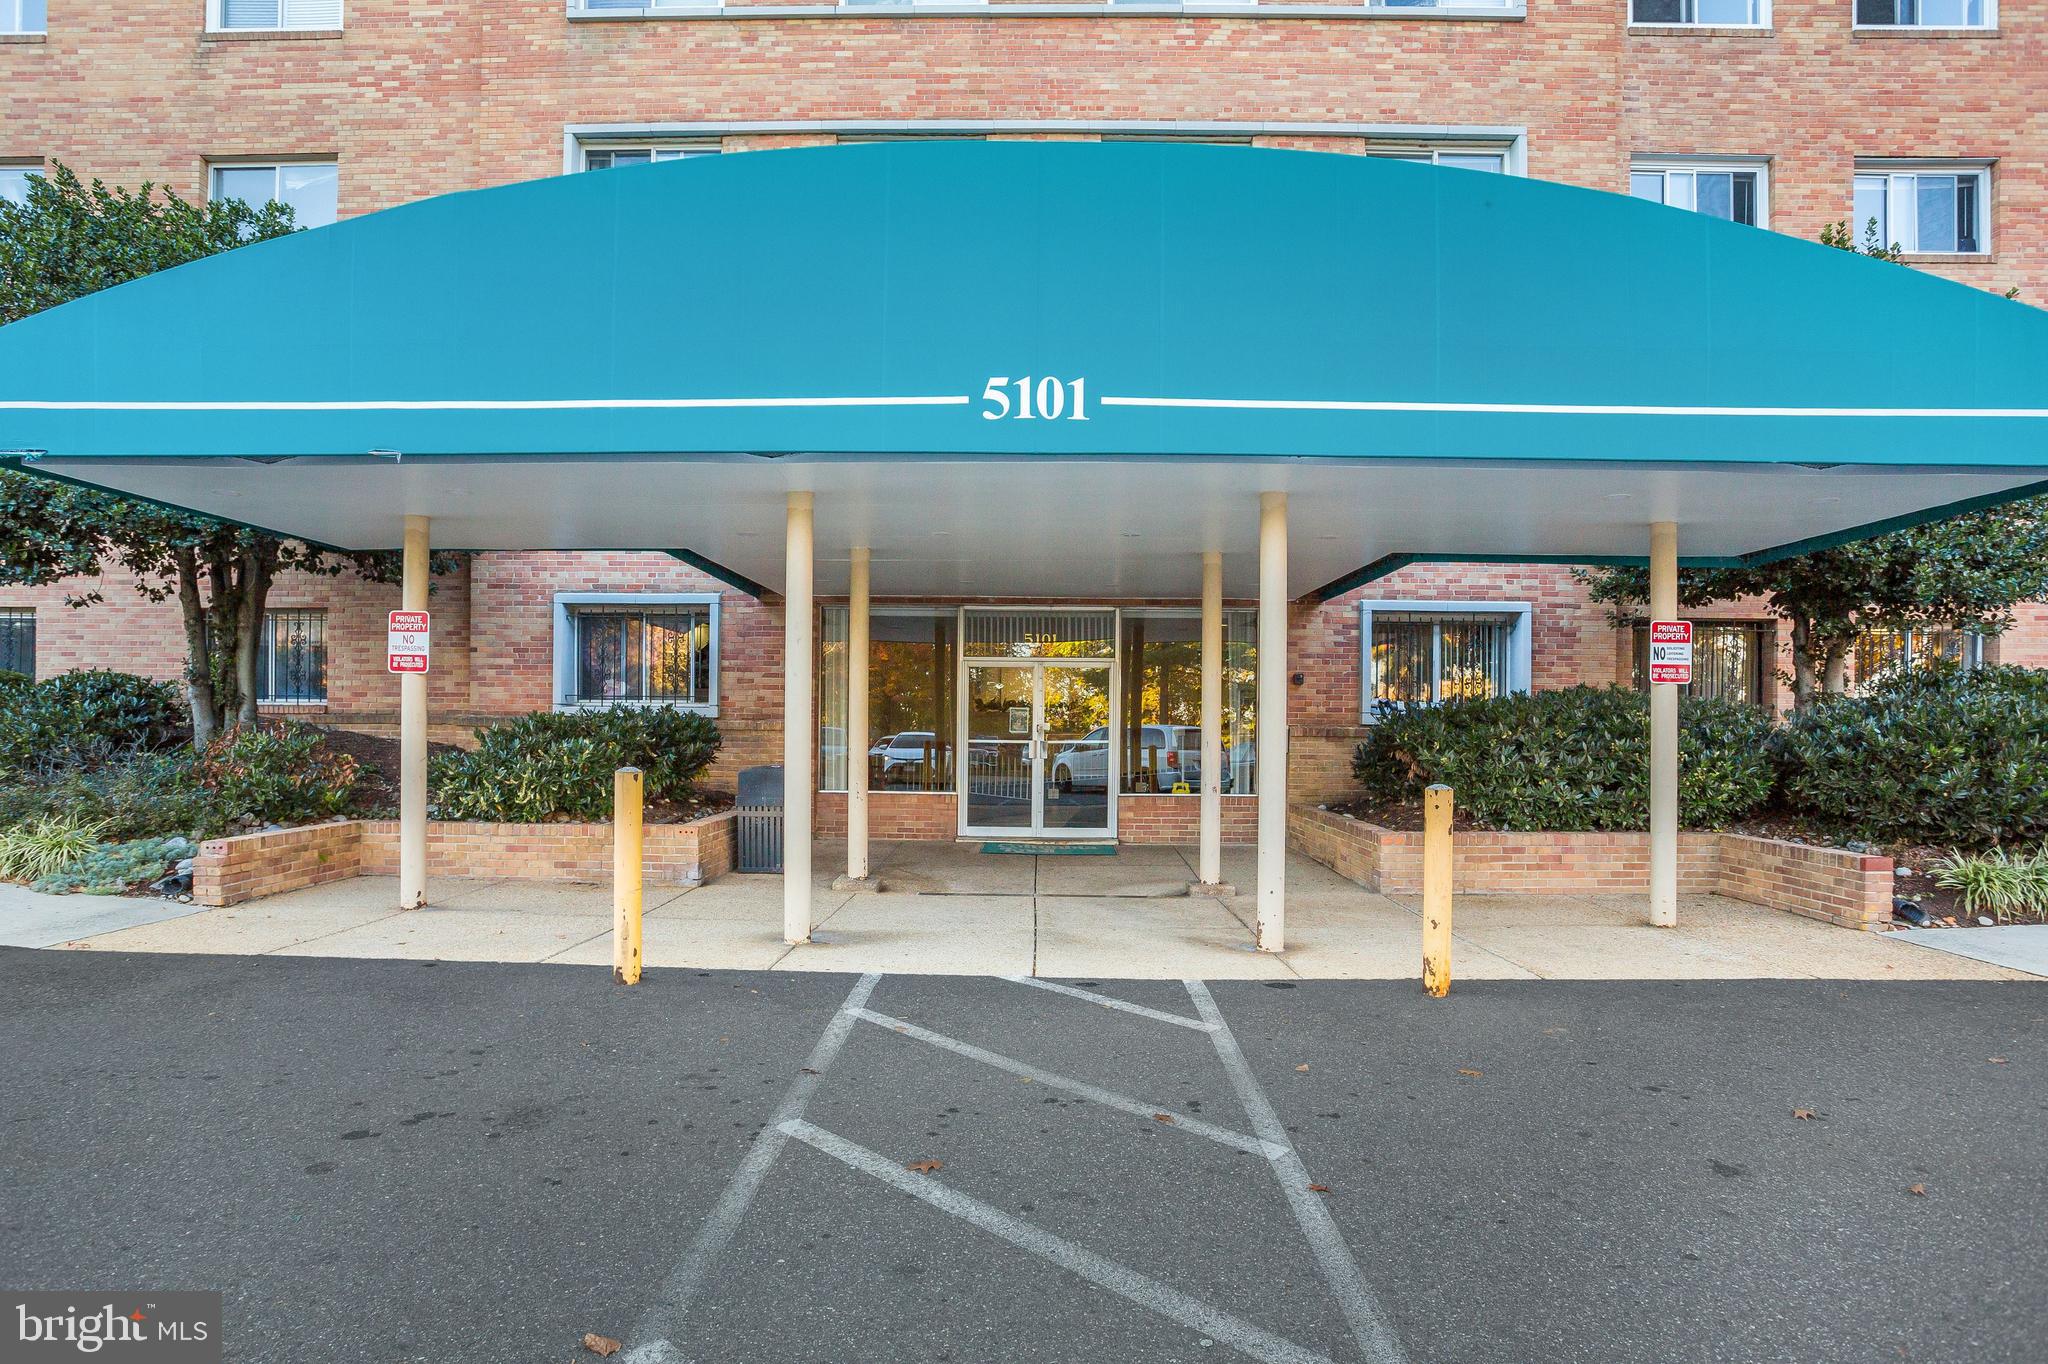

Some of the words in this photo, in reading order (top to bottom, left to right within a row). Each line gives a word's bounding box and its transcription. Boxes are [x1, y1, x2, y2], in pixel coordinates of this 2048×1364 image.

[982, 375, 1091, 421] 5101
[395, 615, 423, 623] PRIVATE
[391, 623, 427, 631] PROPERTY
[1657, 625, 1685, 633] PRIVATE
[402, 634, 415, 645] NO
[1024, 633, 1057, 643] 5101
[1653, 646, 1666, 661] NO
